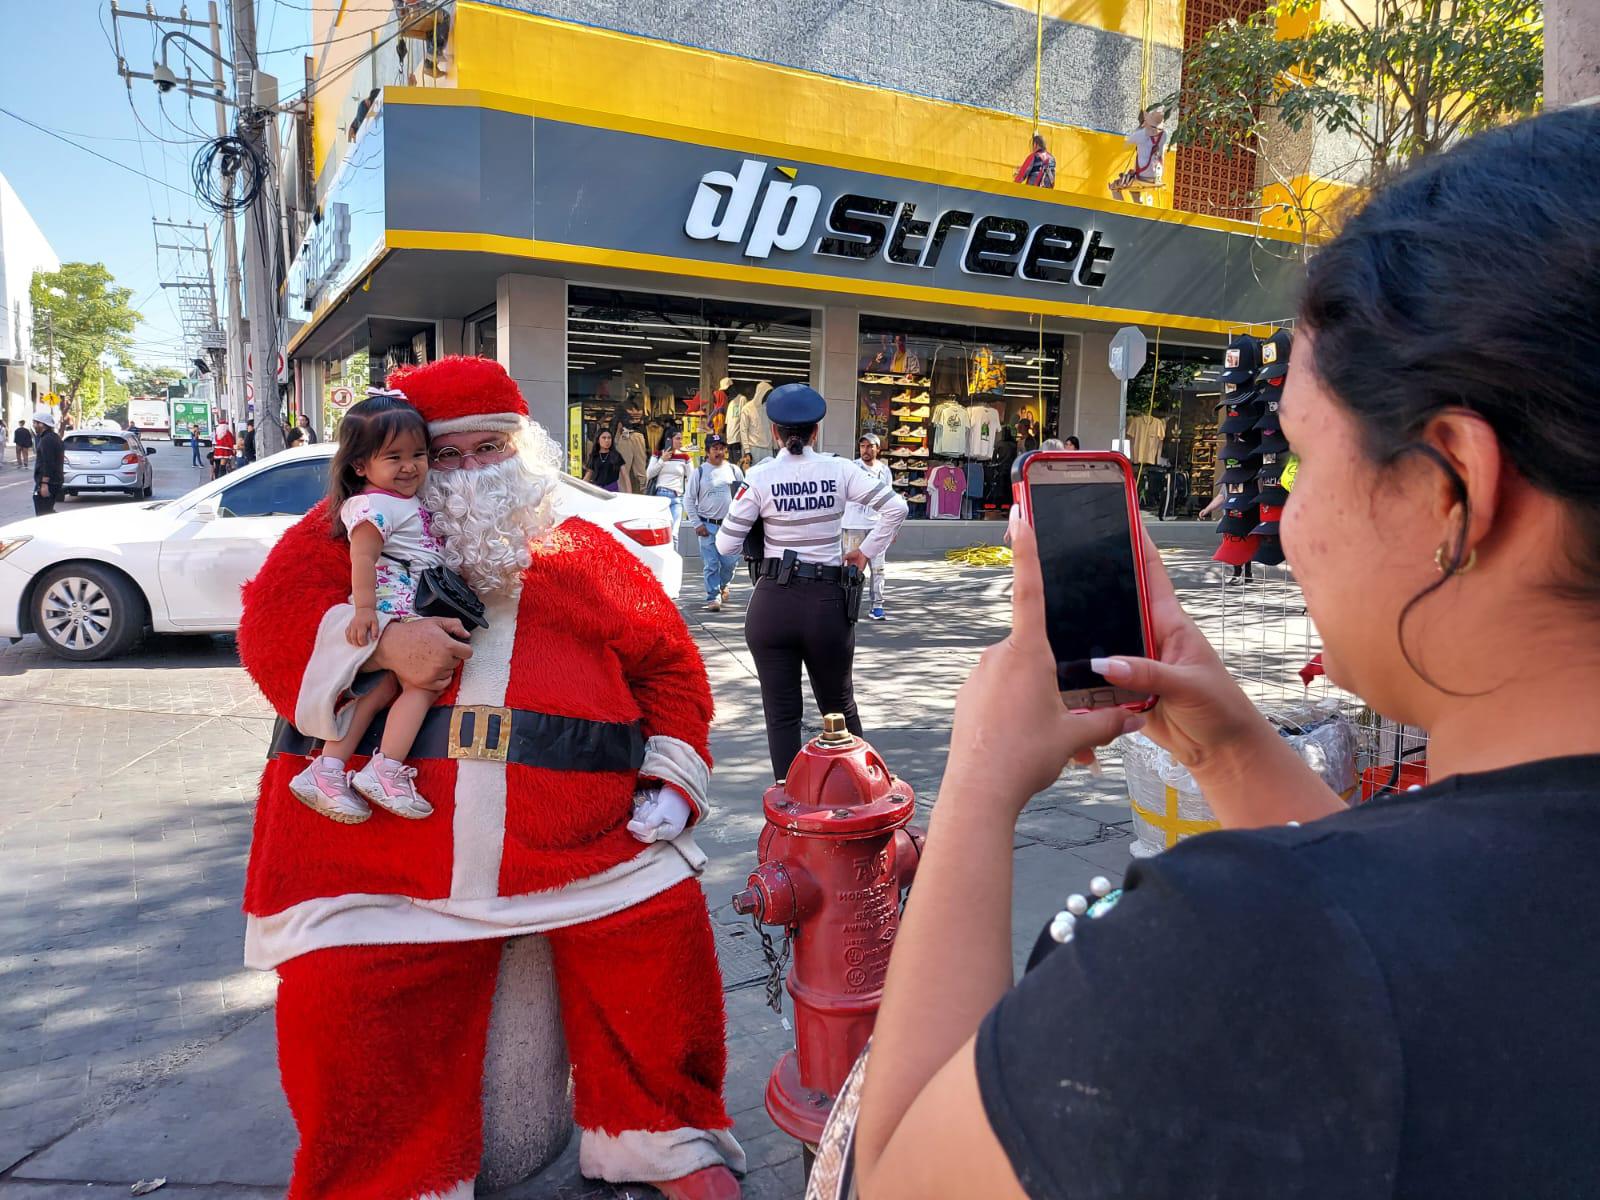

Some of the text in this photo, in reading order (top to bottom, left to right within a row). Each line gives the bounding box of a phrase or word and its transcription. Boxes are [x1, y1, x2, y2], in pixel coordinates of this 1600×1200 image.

[771, 480, 837, 497] UNIDAD DE
[773, 495, 835, 511] VIALIDAD
